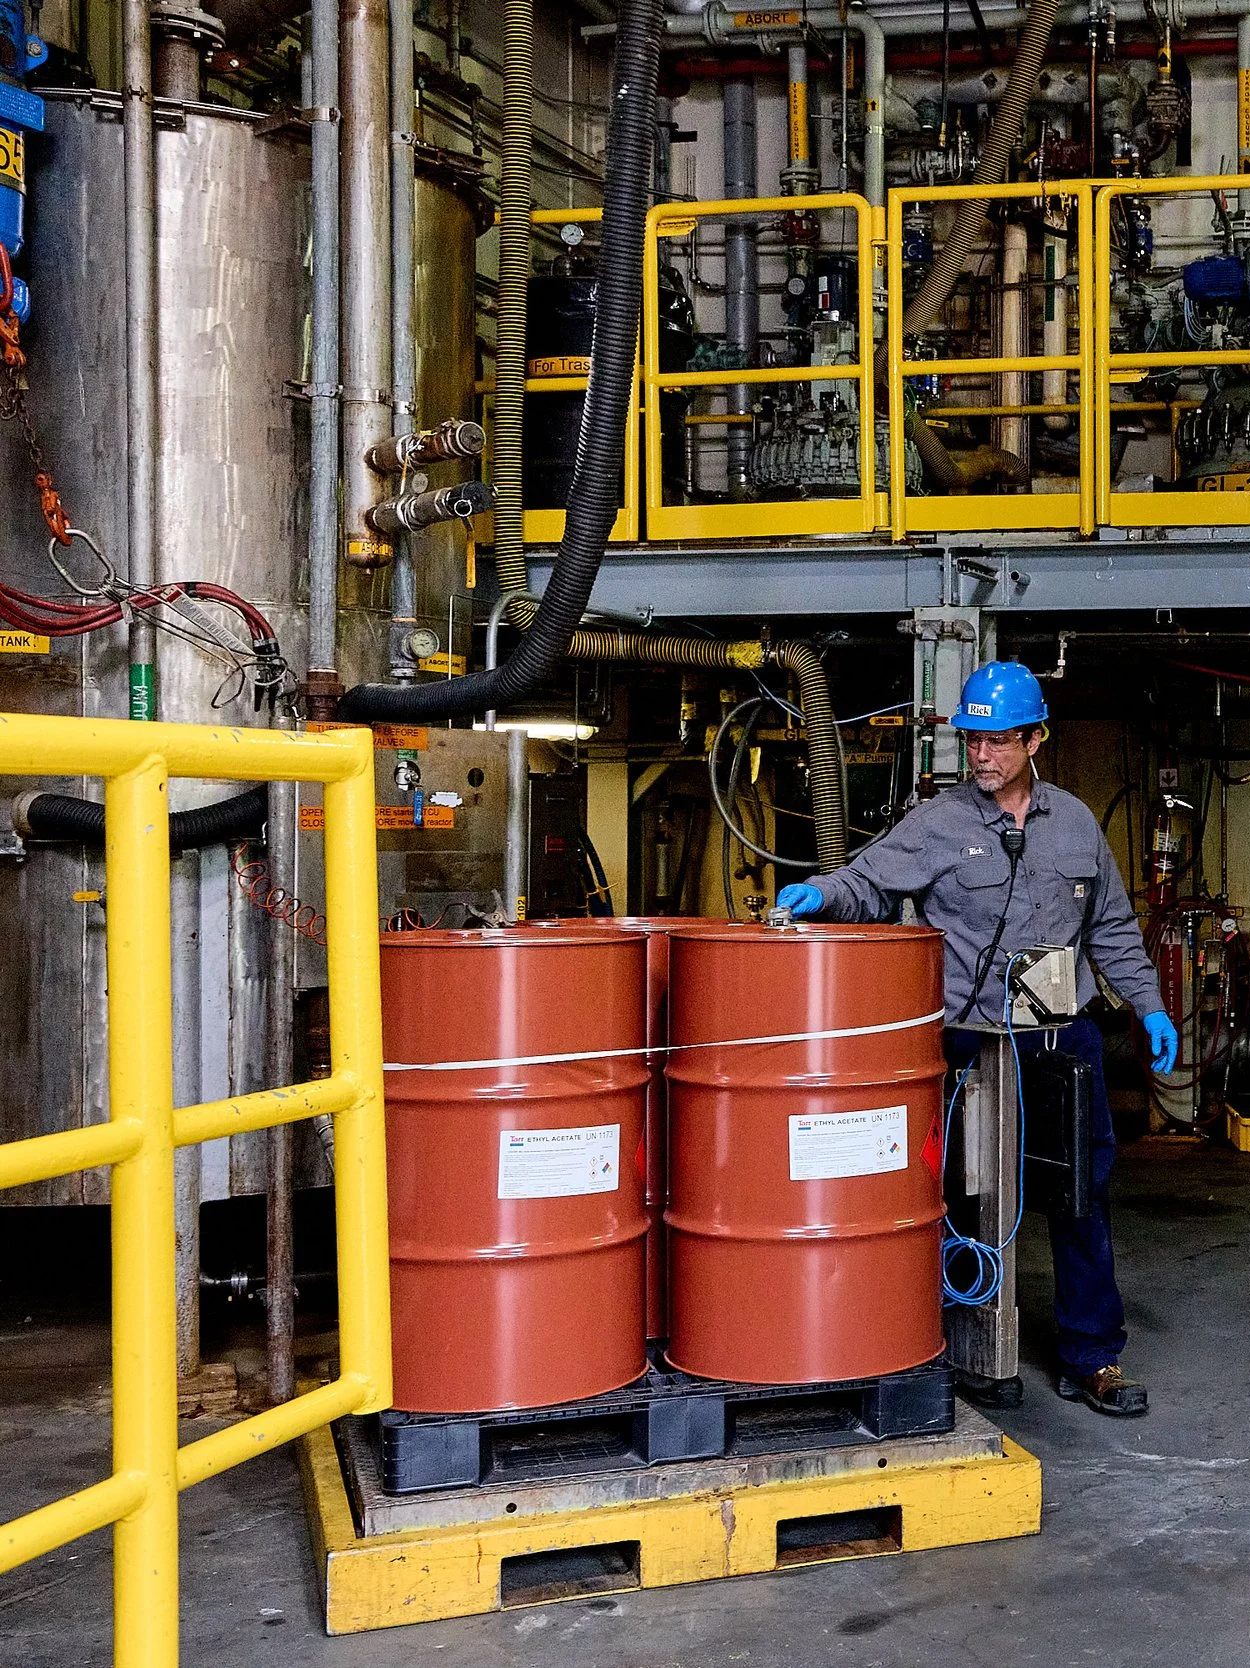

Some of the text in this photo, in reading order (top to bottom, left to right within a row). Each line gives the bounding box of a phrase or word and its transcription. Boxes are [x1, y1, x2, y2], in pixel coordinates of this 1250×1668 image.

[746, 13, 789, 24] ABORT
[534, 358, 591, 373] For Tras
[0, 635, 31, 647] TANK
[970, 704, 990, 716] Rick
[383, 727, 419, 737] BEFORE
[301, 818, 325, 827] CLOS
[427, 818, 452, 826] reactor
[837, 1117, 868, 1125] ACETATE
[871, 1114, 883, 1123] UN
[884, 1111, 900, 1121] 1173
[551, 1134, 582, 1142] ACETATE
[585, 1132, 597, 1141] UN
[599, 1130, 614, 1139] 1173
